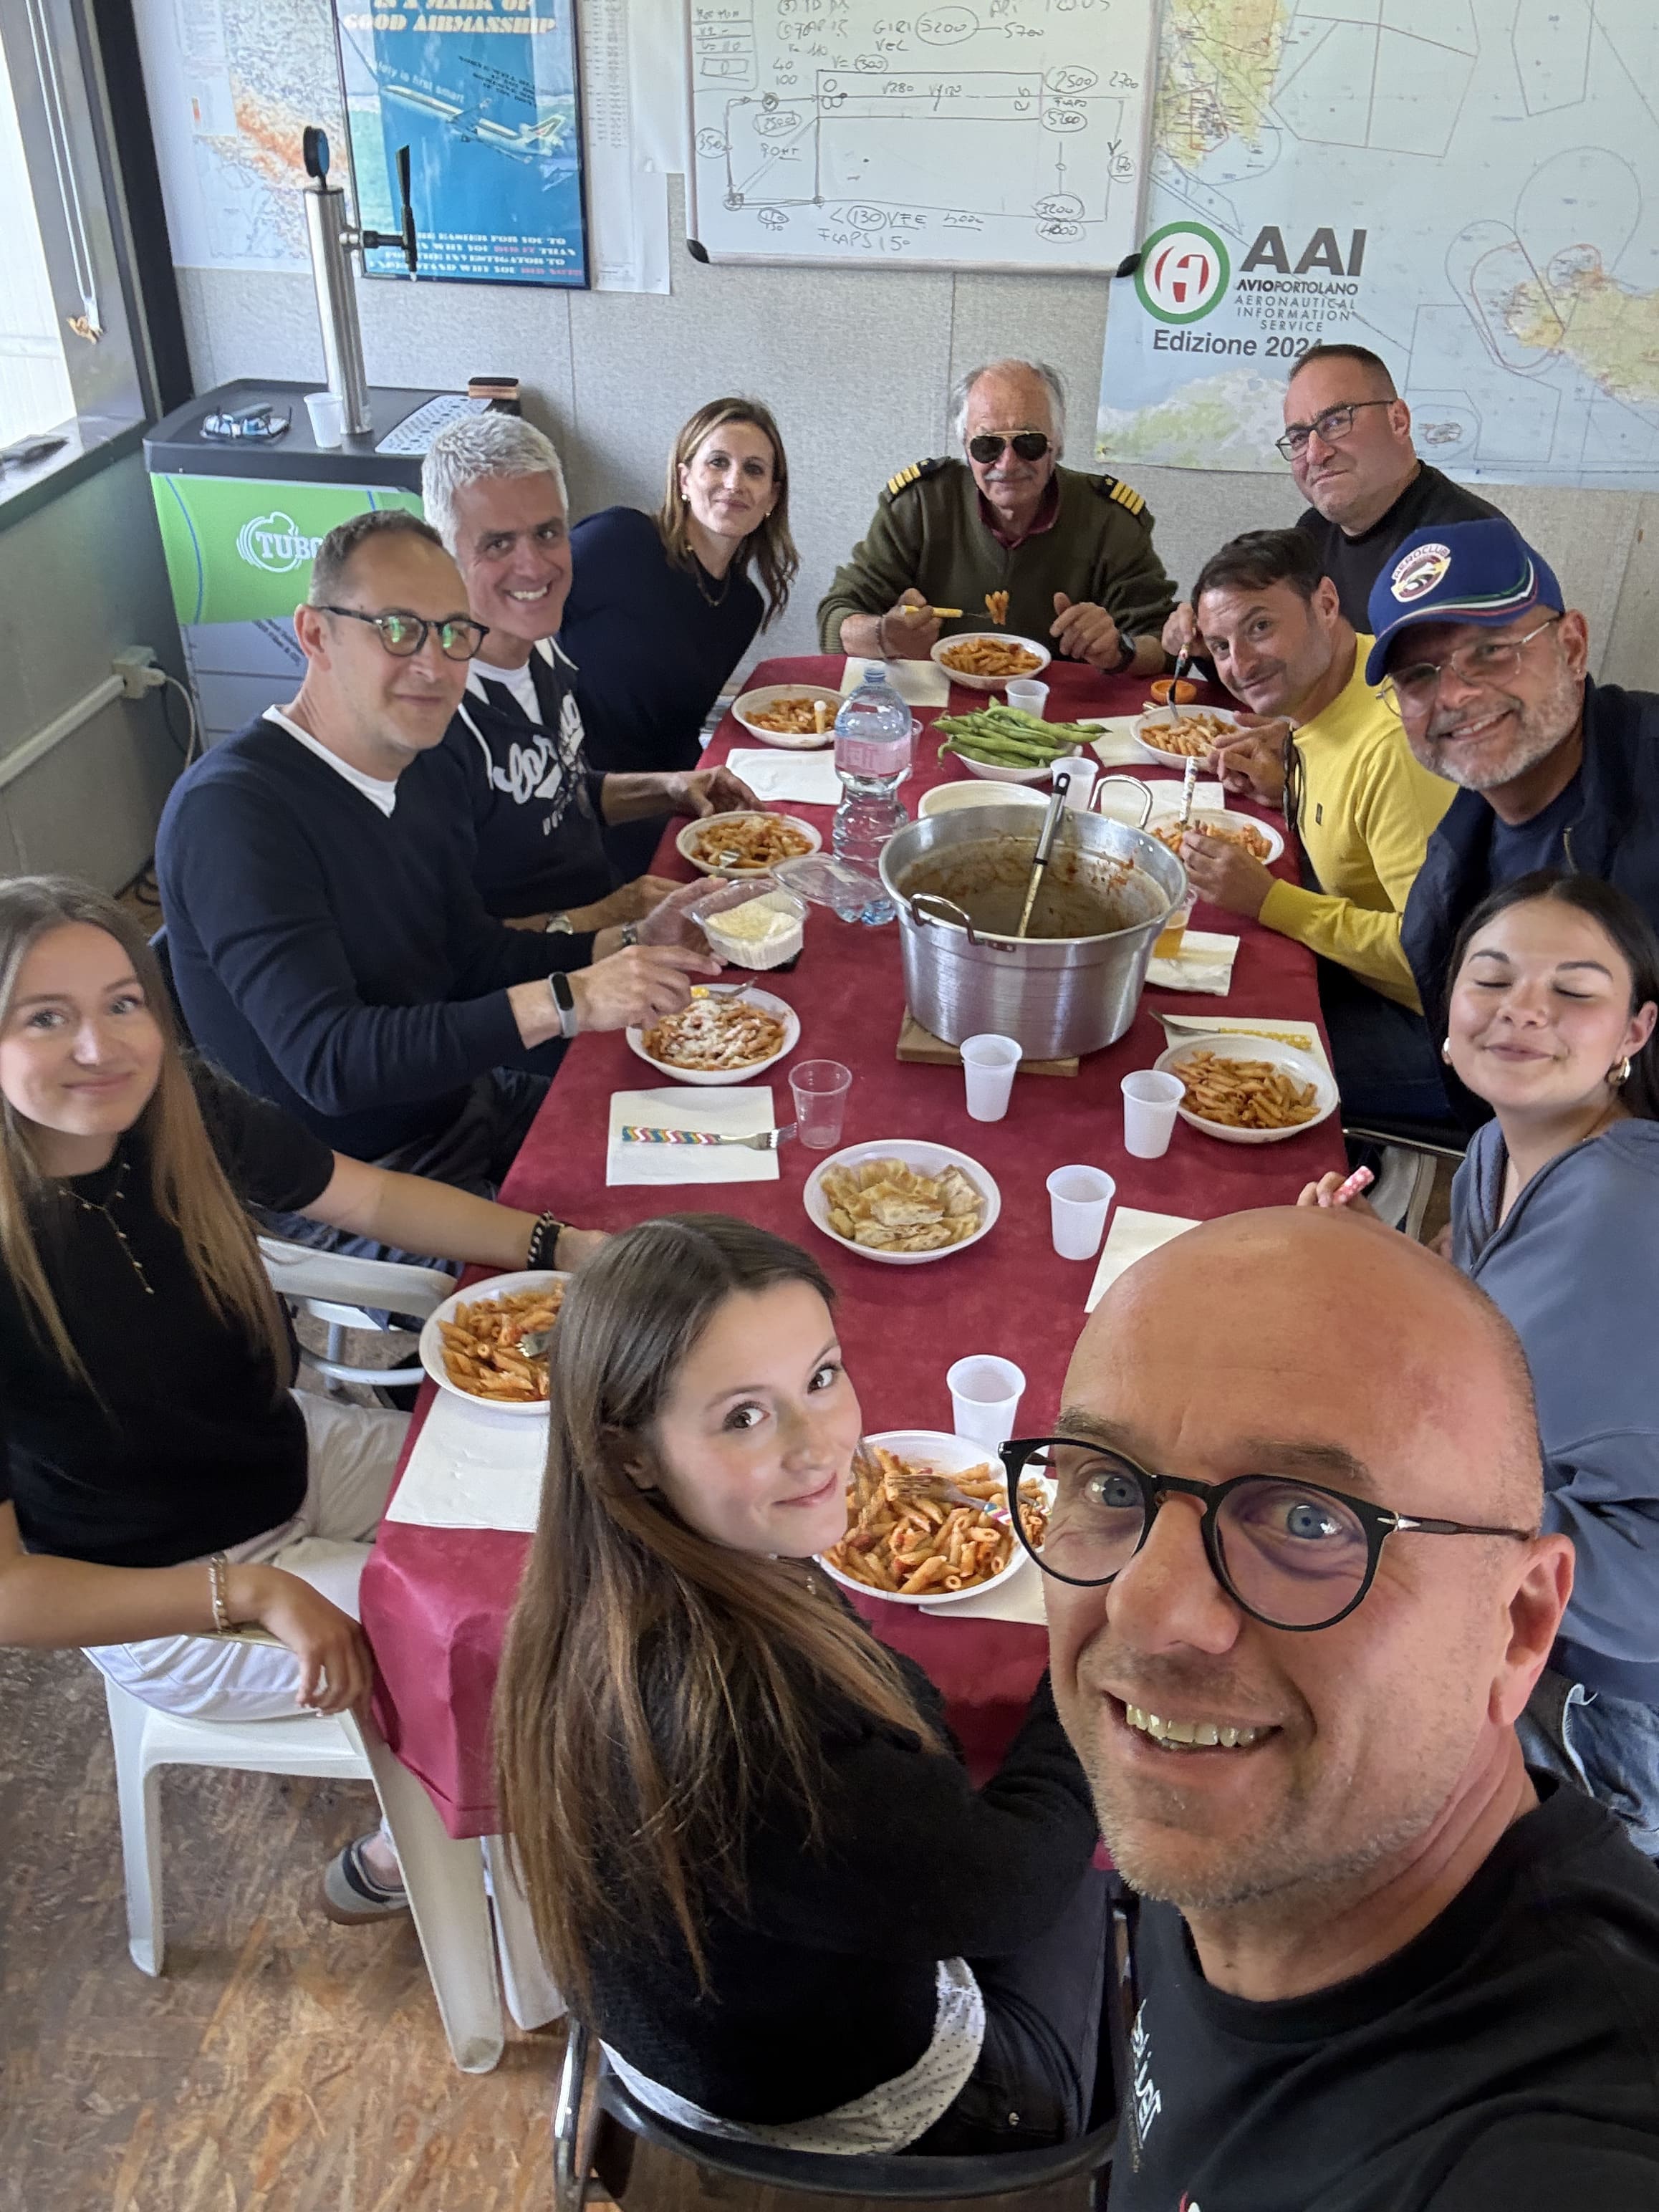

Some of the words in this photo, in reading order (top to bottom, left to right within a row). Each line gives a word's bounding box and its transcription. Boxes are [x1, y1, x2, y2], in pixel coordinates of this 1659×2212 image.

[343, 13, 407, 31] GOOD
[413, 14, 556, 34] AIRMANSHIP
[776, 74, 798, 85] 100
[853, 210, 883, 224] 130
[1239, 226, 1367, 276] AAI
[1236, 279, 1359, 295] AVIOPORTOLANO
[1234, 294, 1356, 309] AERONAUTICAL
[1237, 308, 1350, 321] INFORMATION
[1260, 319, 1324, 332] SERVICE
[1153, 328, 1258, 357] Edizione
[1394, 546, 1448, 579] AEROCLUB
